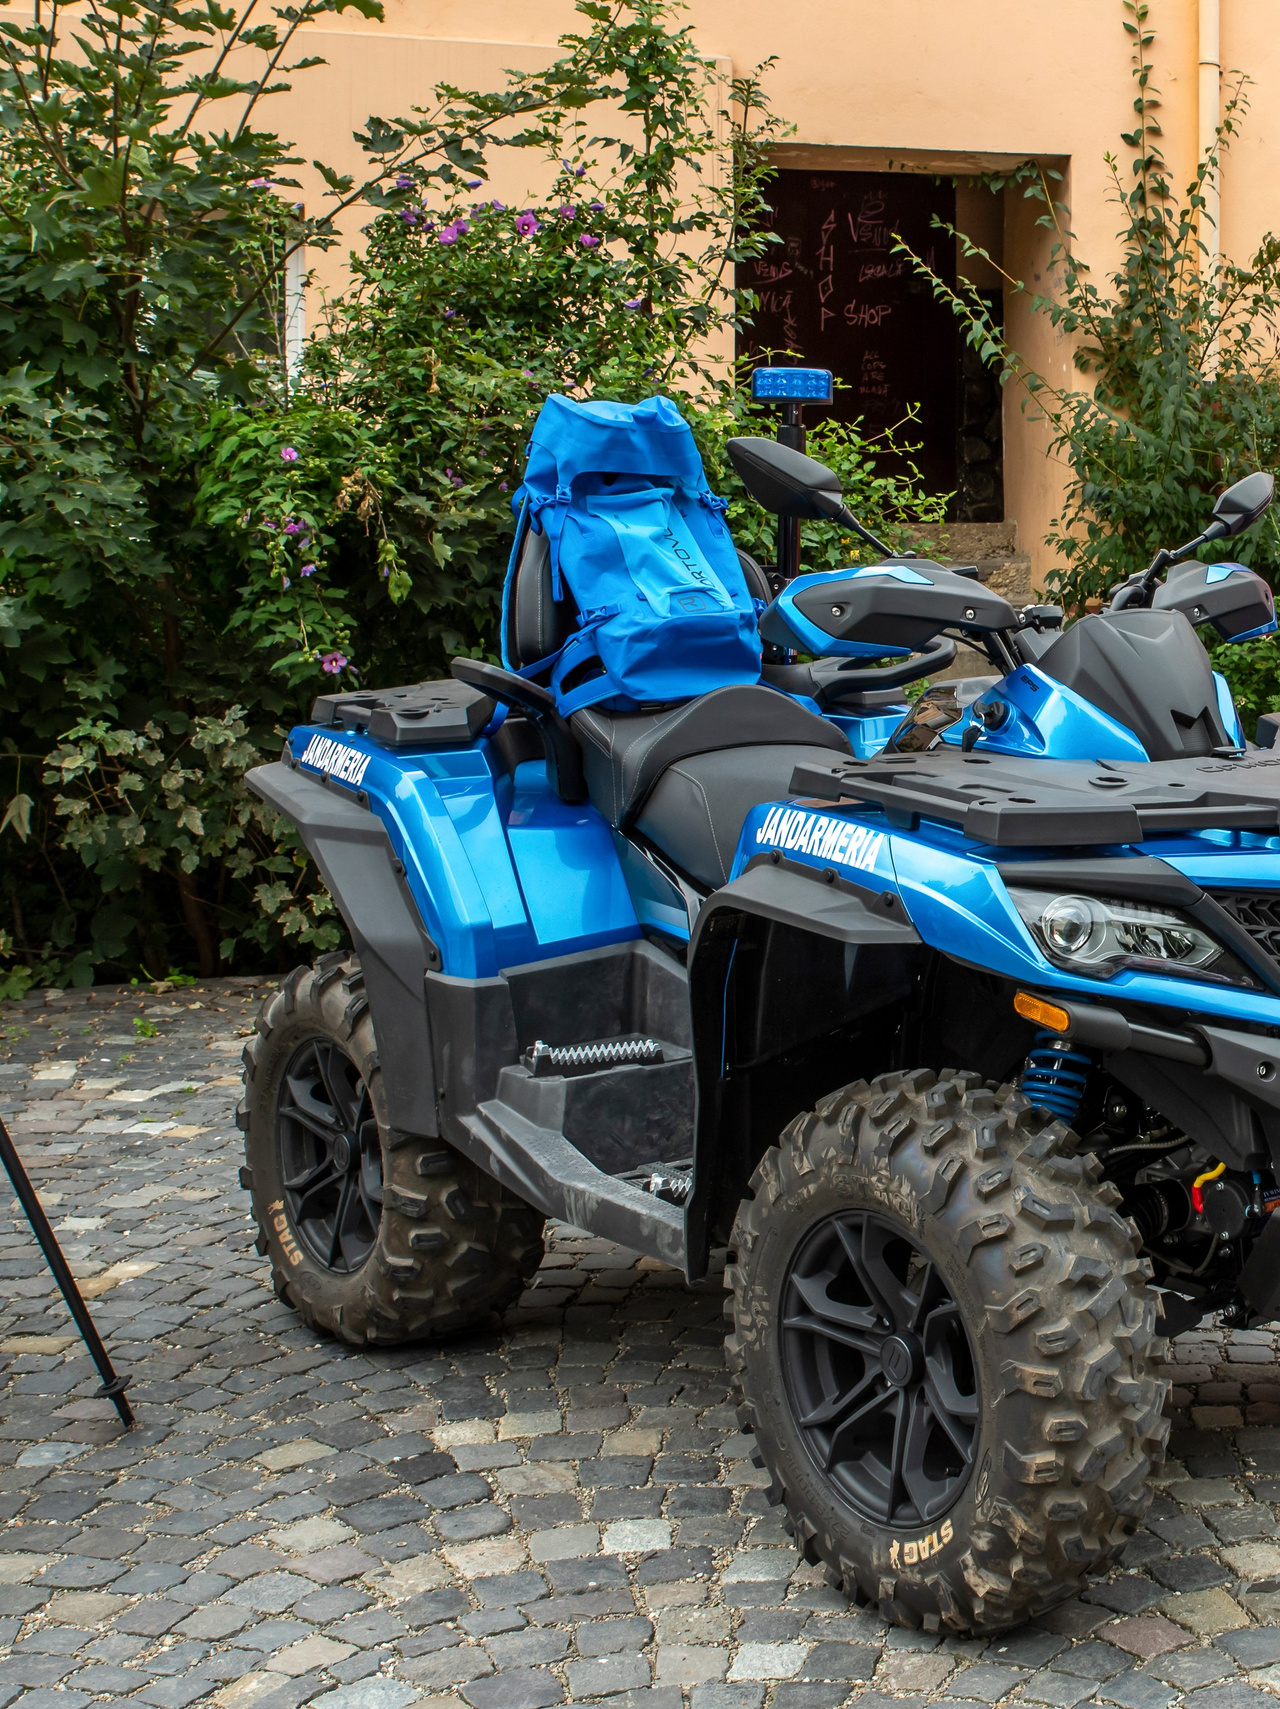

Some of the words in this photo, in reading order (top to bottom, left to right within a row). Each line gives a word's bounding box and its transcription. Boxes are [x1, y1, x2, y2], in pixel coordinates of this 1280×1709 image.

[844, 299, 892, 328] SHOP
[1020, 674, 1040, 692] EPS
[301, 733, 372, 786] JANDARMERIA
[755, 806, 886, 873] JANDARMERIA
[273, 1213, 304, 1267] STAG
[903, 1518, 954, 1566] STAG
